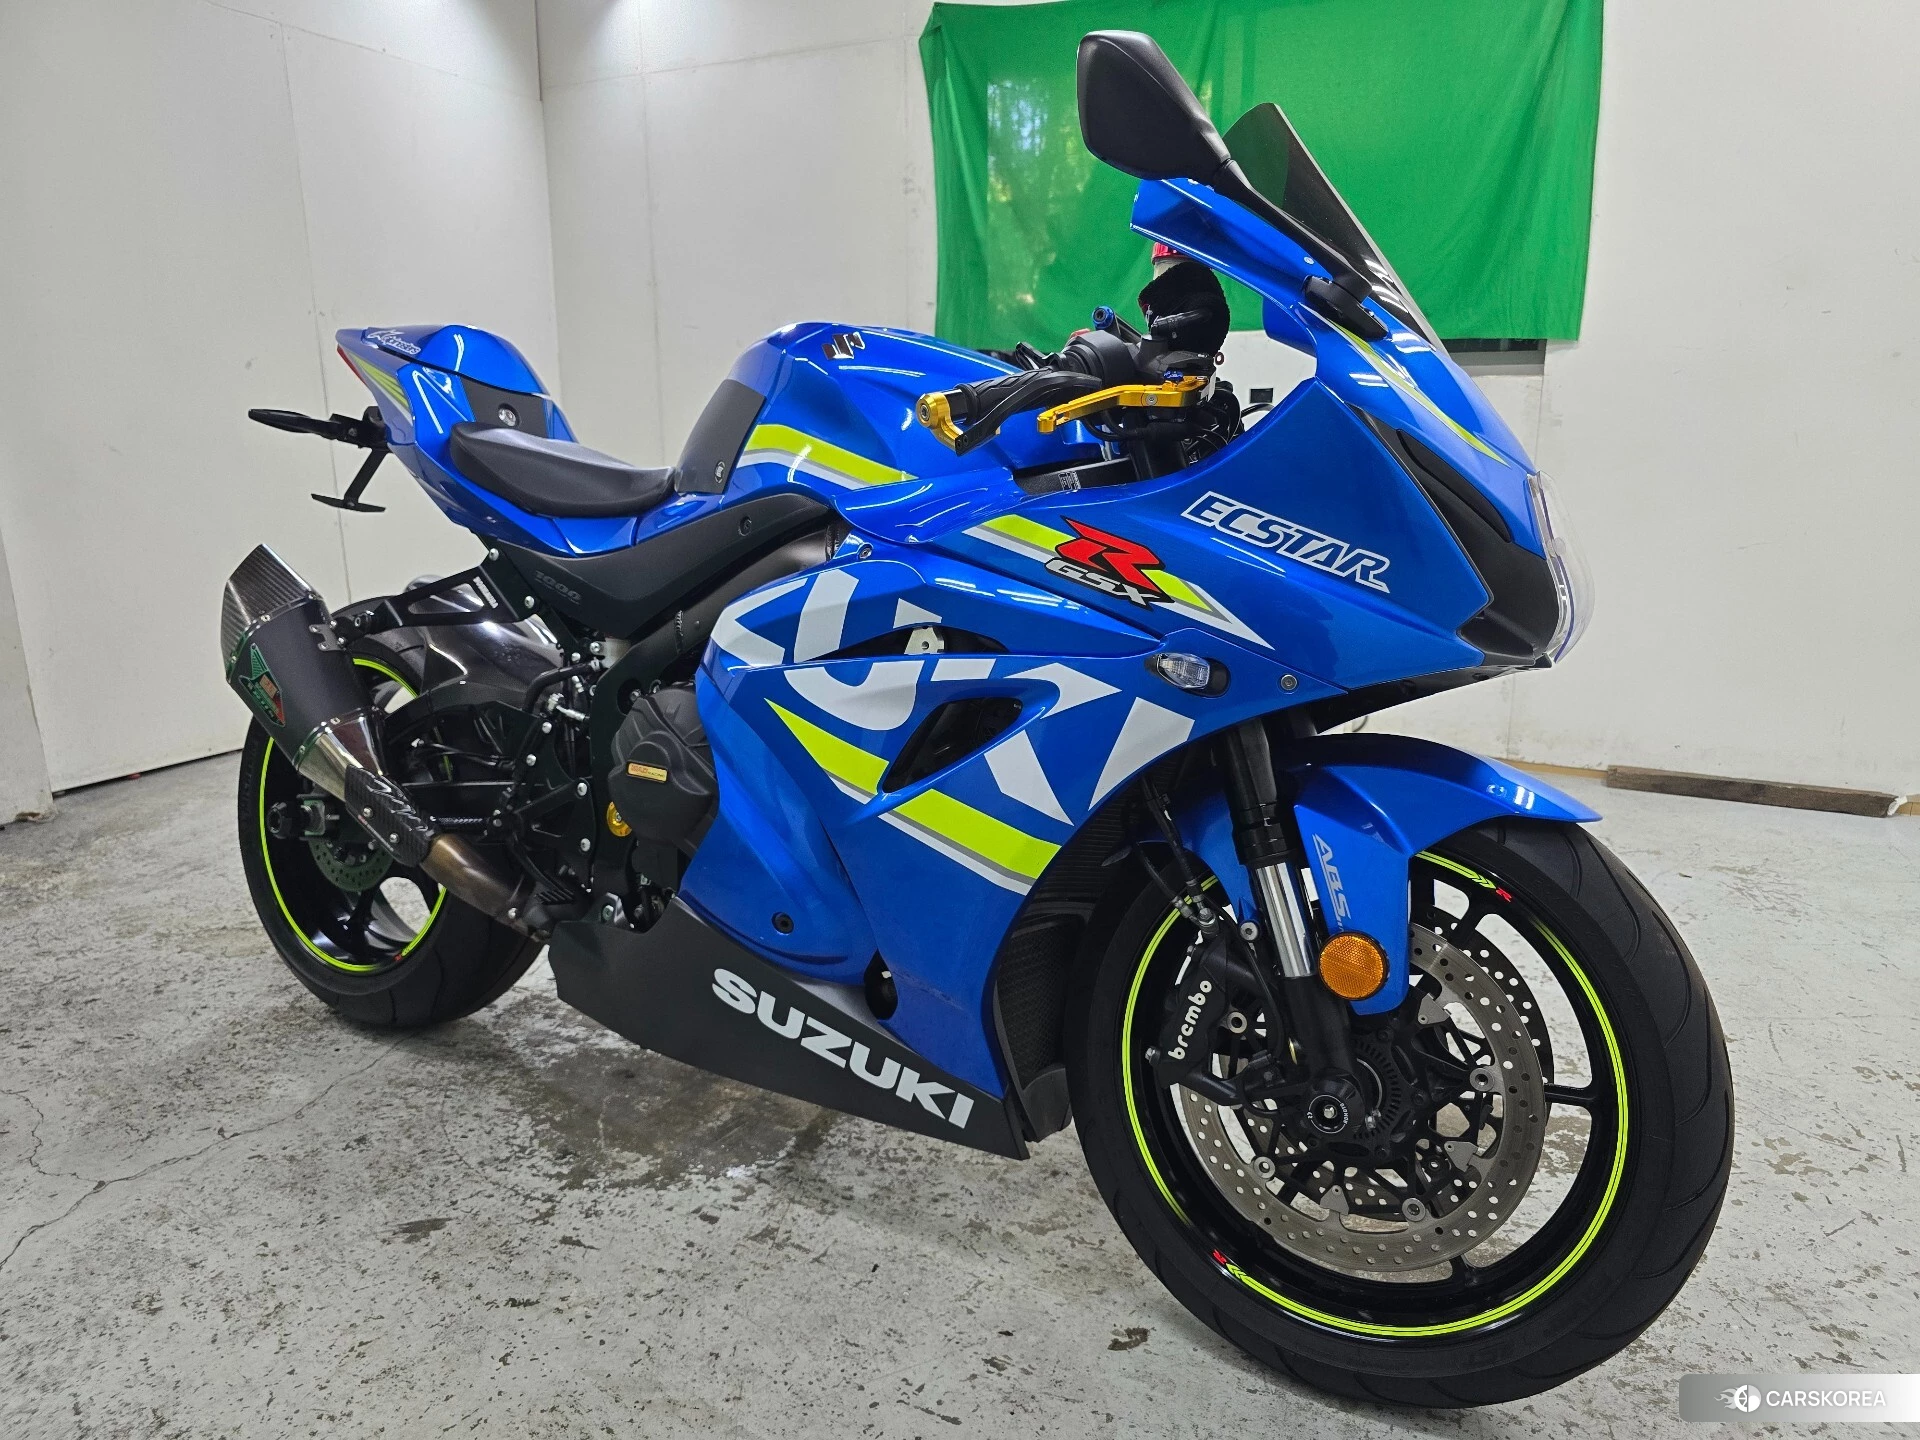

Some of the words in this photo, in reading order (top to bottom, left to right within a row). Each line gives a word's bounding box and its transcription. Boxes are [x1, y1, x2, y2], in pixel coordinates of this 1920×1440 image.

[1045, 559, 1161, 606] GSX
[1181, 491, 1391, 593] ECSTAR
[1312, 833, 1351, 921] ABS
[712, 968, 974, 1129] SUZUKI
[1167, 980, 1213, 1060] brembo
